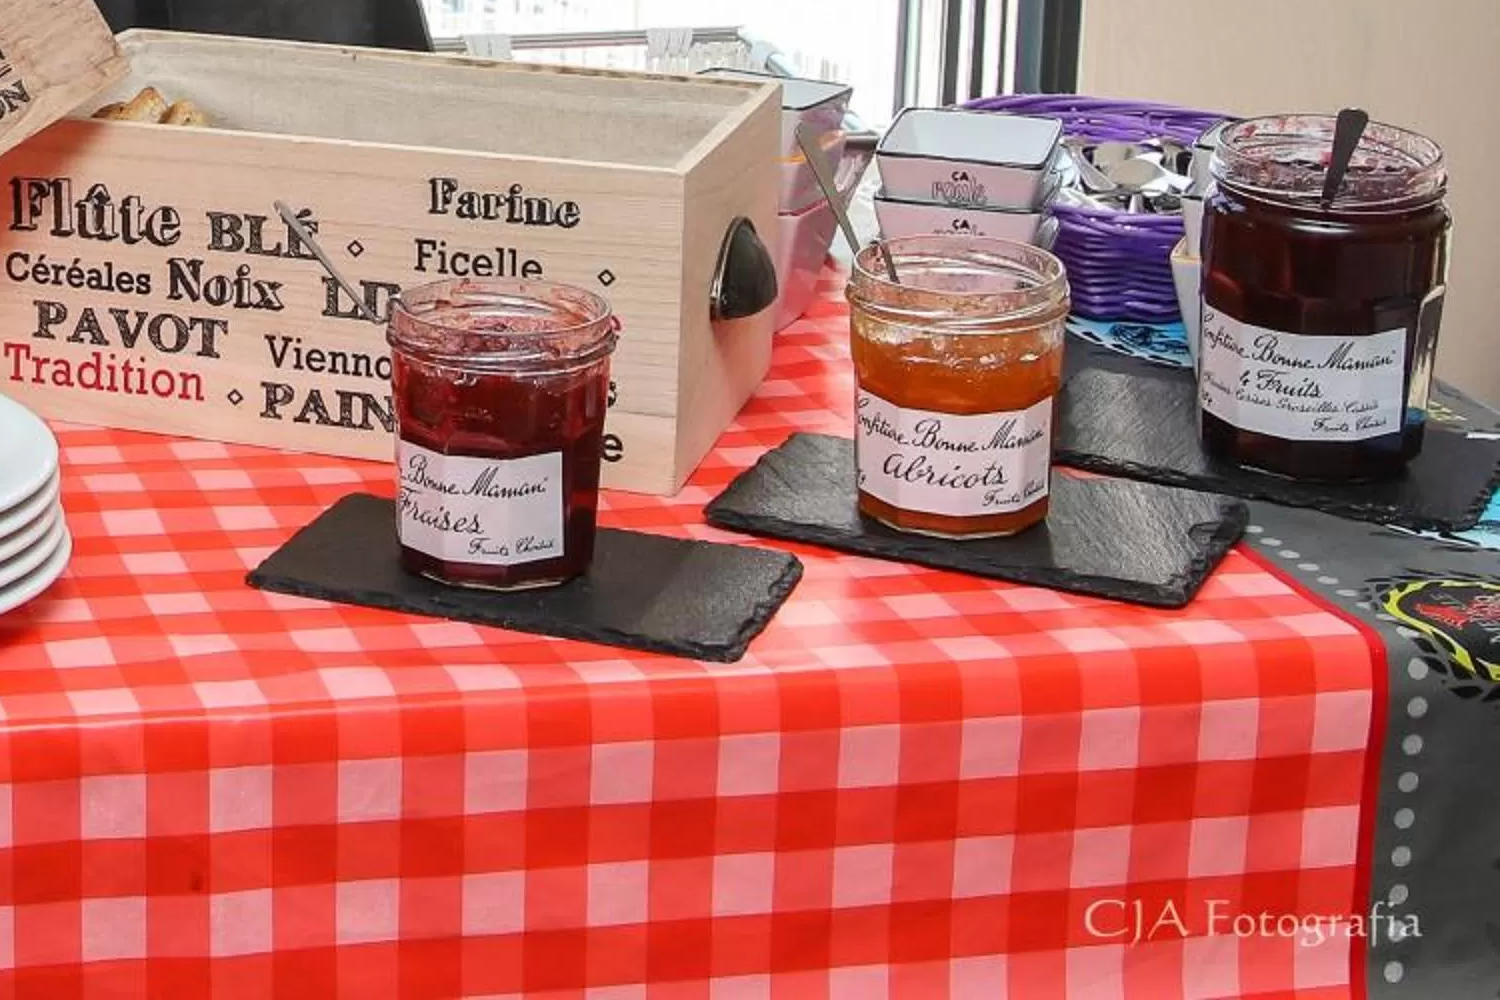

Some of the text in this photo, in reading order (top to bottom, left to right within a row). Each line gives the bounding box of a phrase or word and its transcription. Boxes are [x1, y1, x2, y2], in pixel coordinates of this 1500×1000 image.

[8, 177, 181, 246] Flûte
[428, 177, 581, 228] Farine
[5, 251, 151, 295] Céréales
[166, 258, 285, 311] Noix
[413, 238, 543, 280] Ficelle
[32, 300, 228, 359] PAVOT
[1252, 333, 1315, 369] Bonne
[1317, 341, 1393, 371] Maman
[3, 342, 205, 401] Tradition
[265, 335, 393, 380] Vienno
[1256, 369, 1323, 398] Fruits
[912, 418, 979, 452] Bonne
[408, 453, 547, 498] Bonne Maman
[400, 486, 484, 534] Fraises
